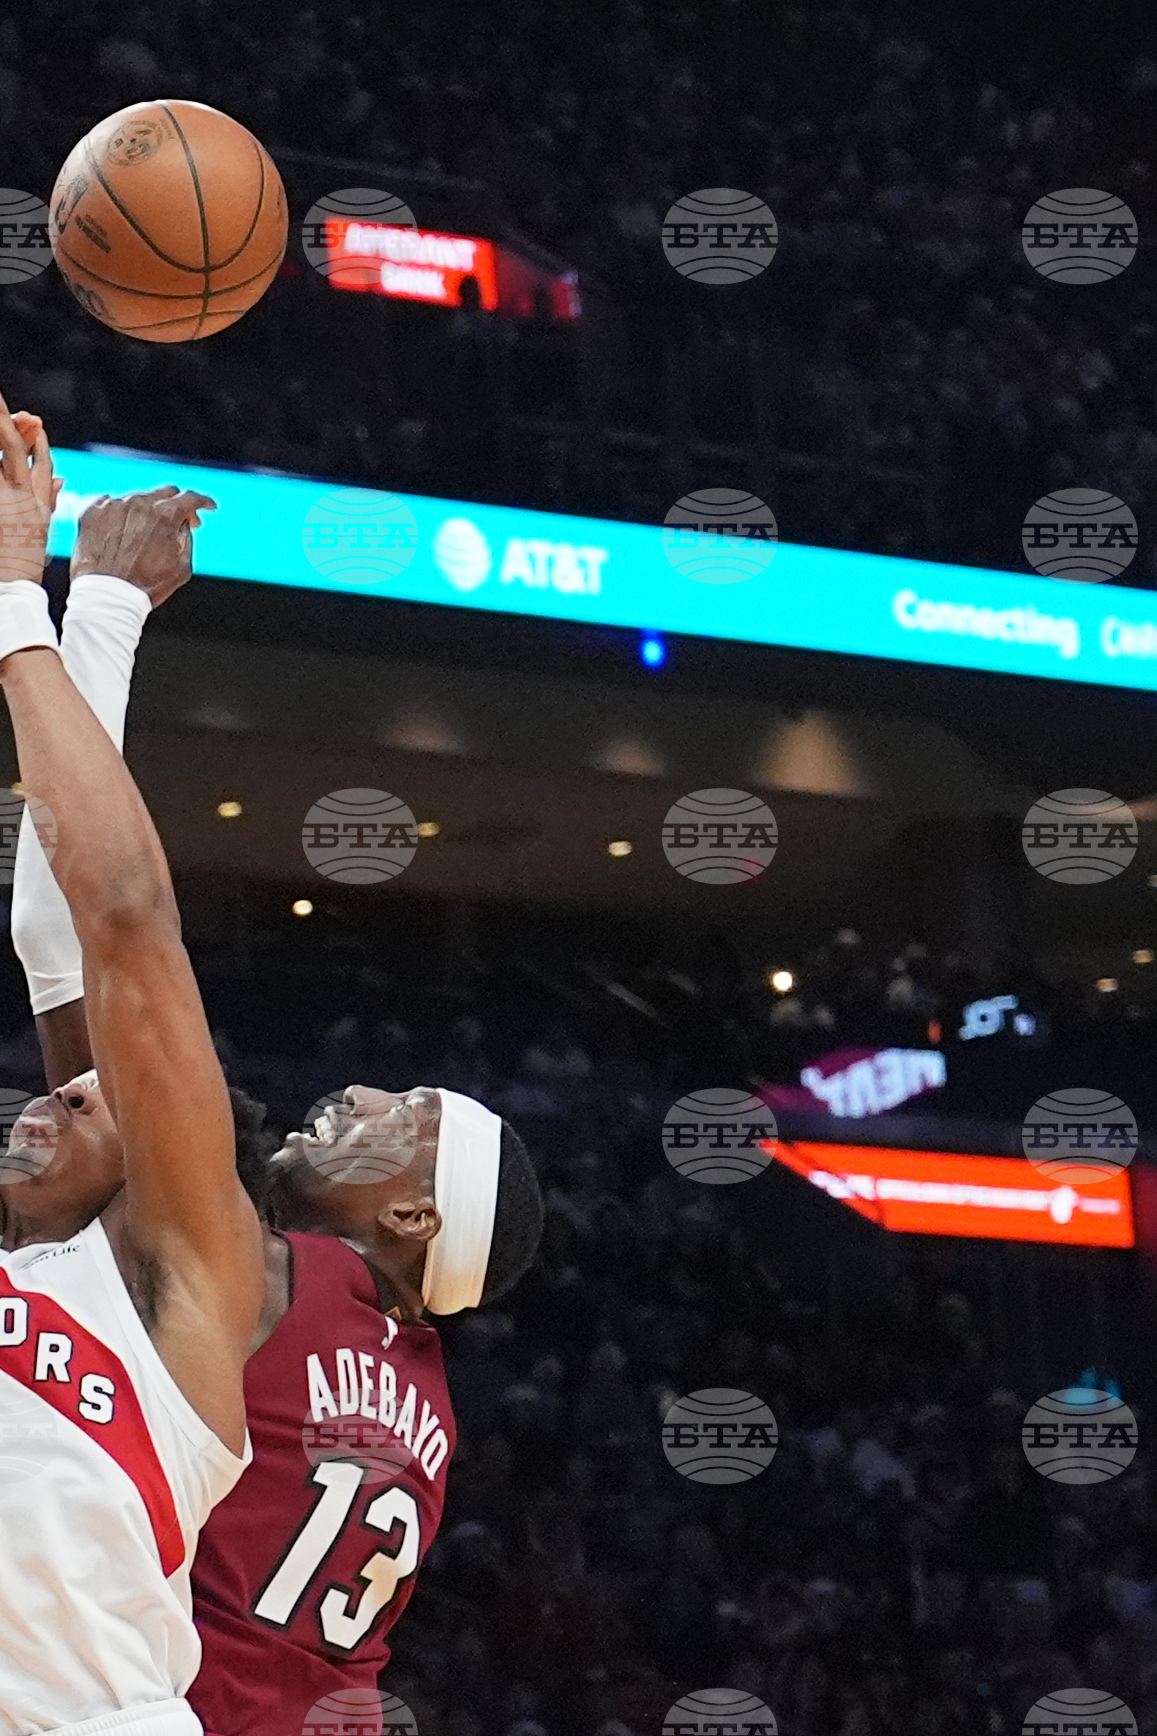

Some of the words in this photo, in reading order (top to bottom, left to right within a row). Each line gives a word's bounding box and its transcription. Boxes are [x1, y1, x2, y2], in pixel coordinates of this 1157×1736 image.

[499, 537, 609, 596] AT&T
[893, 588, 1081, 660] Connecting
[305, 1347, 449, 1482] ADEBAYO
[251, 1459, 424, 1653] 13
